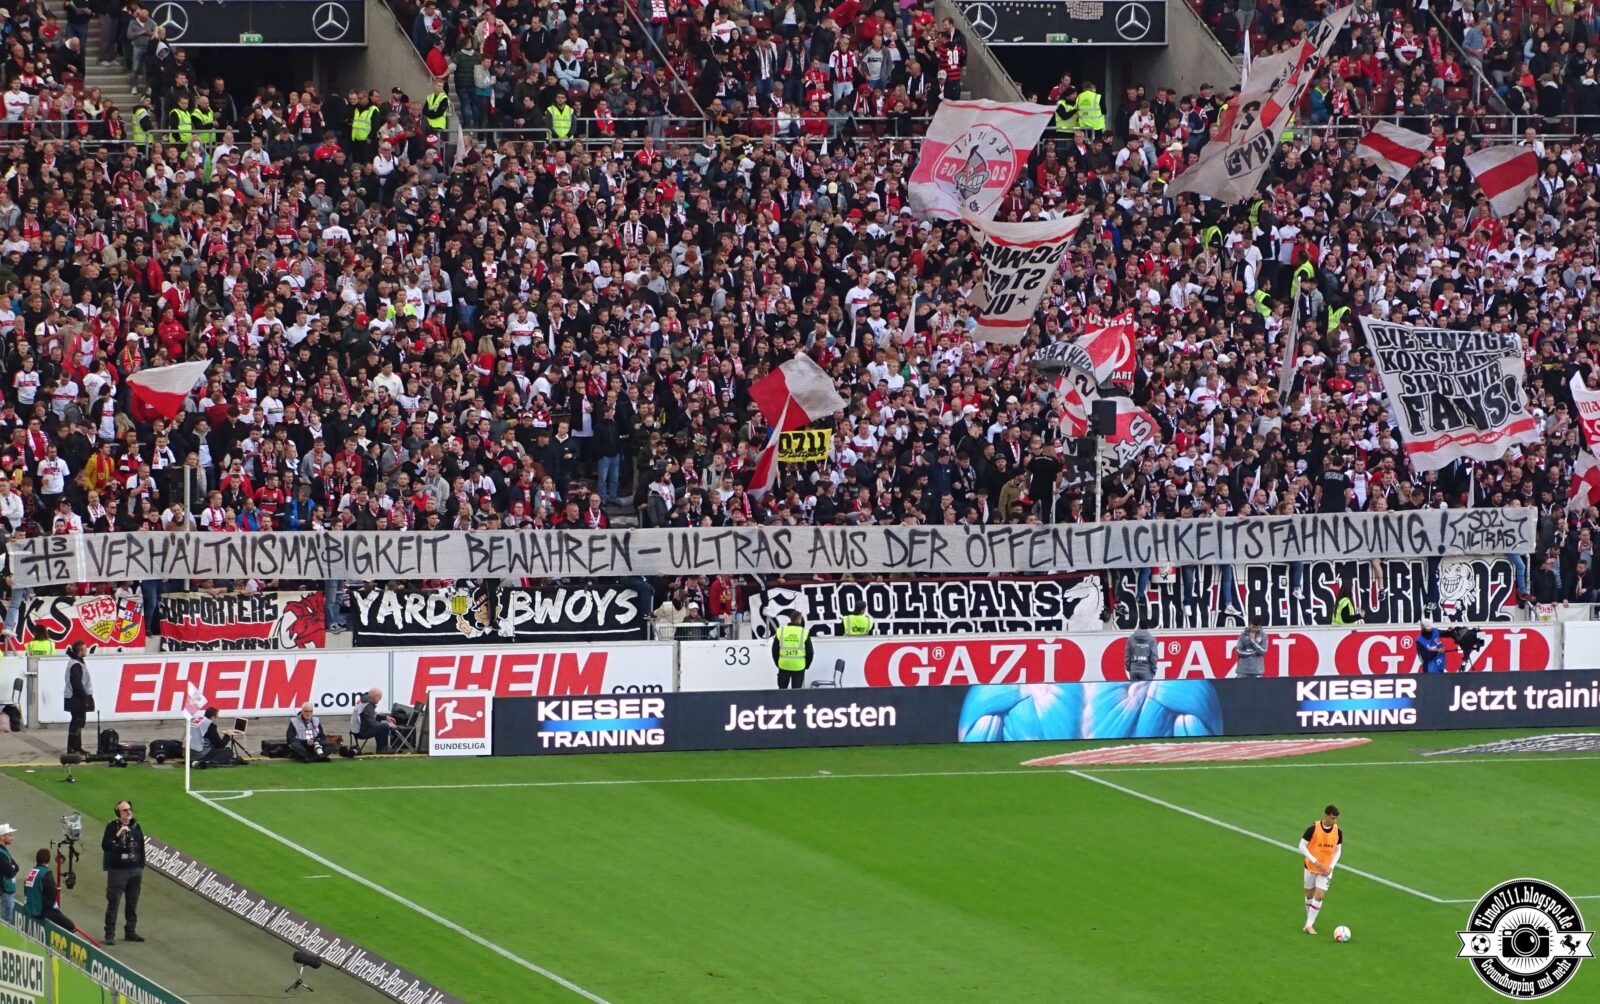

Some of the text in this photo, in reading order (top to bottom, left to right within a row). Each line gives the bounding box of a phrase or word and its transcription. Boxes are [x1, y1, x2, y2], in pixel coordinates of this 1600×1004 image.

[1370, 325, 1415, 349] DIE
[1401, 361, 1503, 397] SIND WIR
[1399, 374, 1523, 436] FANS!
[779, 431, 826, 453] 0711
[667, 527, 793, 570] ULTRAS
[807, 527, 869, 569] AUS
[883, 526, 952, 570] DER
[1458, 528, 1517, 551] ULTRAS
[353, 587, 639, 630] YARD BWOYS
[803, 581, 1063, 621] HOOLIGANS
[724, 646, 751, 666] 33
[1296, 678, 1417, 701] KIESER
[1449, 680, 1600, 712] Jetzt traini
[537, 697, 665, 722] KIESER
[724, 702, 897, 732] Jetzt testen
[1296, 708, 1417, 727] TRAINING
[434, 742, 486, 750] BUNDESLIGA
[537, 728, 665, 749] TRAINING
[178, 860, 208, 890] Bank
[195, 871, 256, 917] Mercedes-Benz
[246, 899, 279, 928] Bank
[265, 908, 329, 955] Mercedes-Benz
[321, 938, 355, 966] Bank
[342, 948, 409, 997] Mercedes-Benz
[0, 950, 43, 993] BBRUCH
